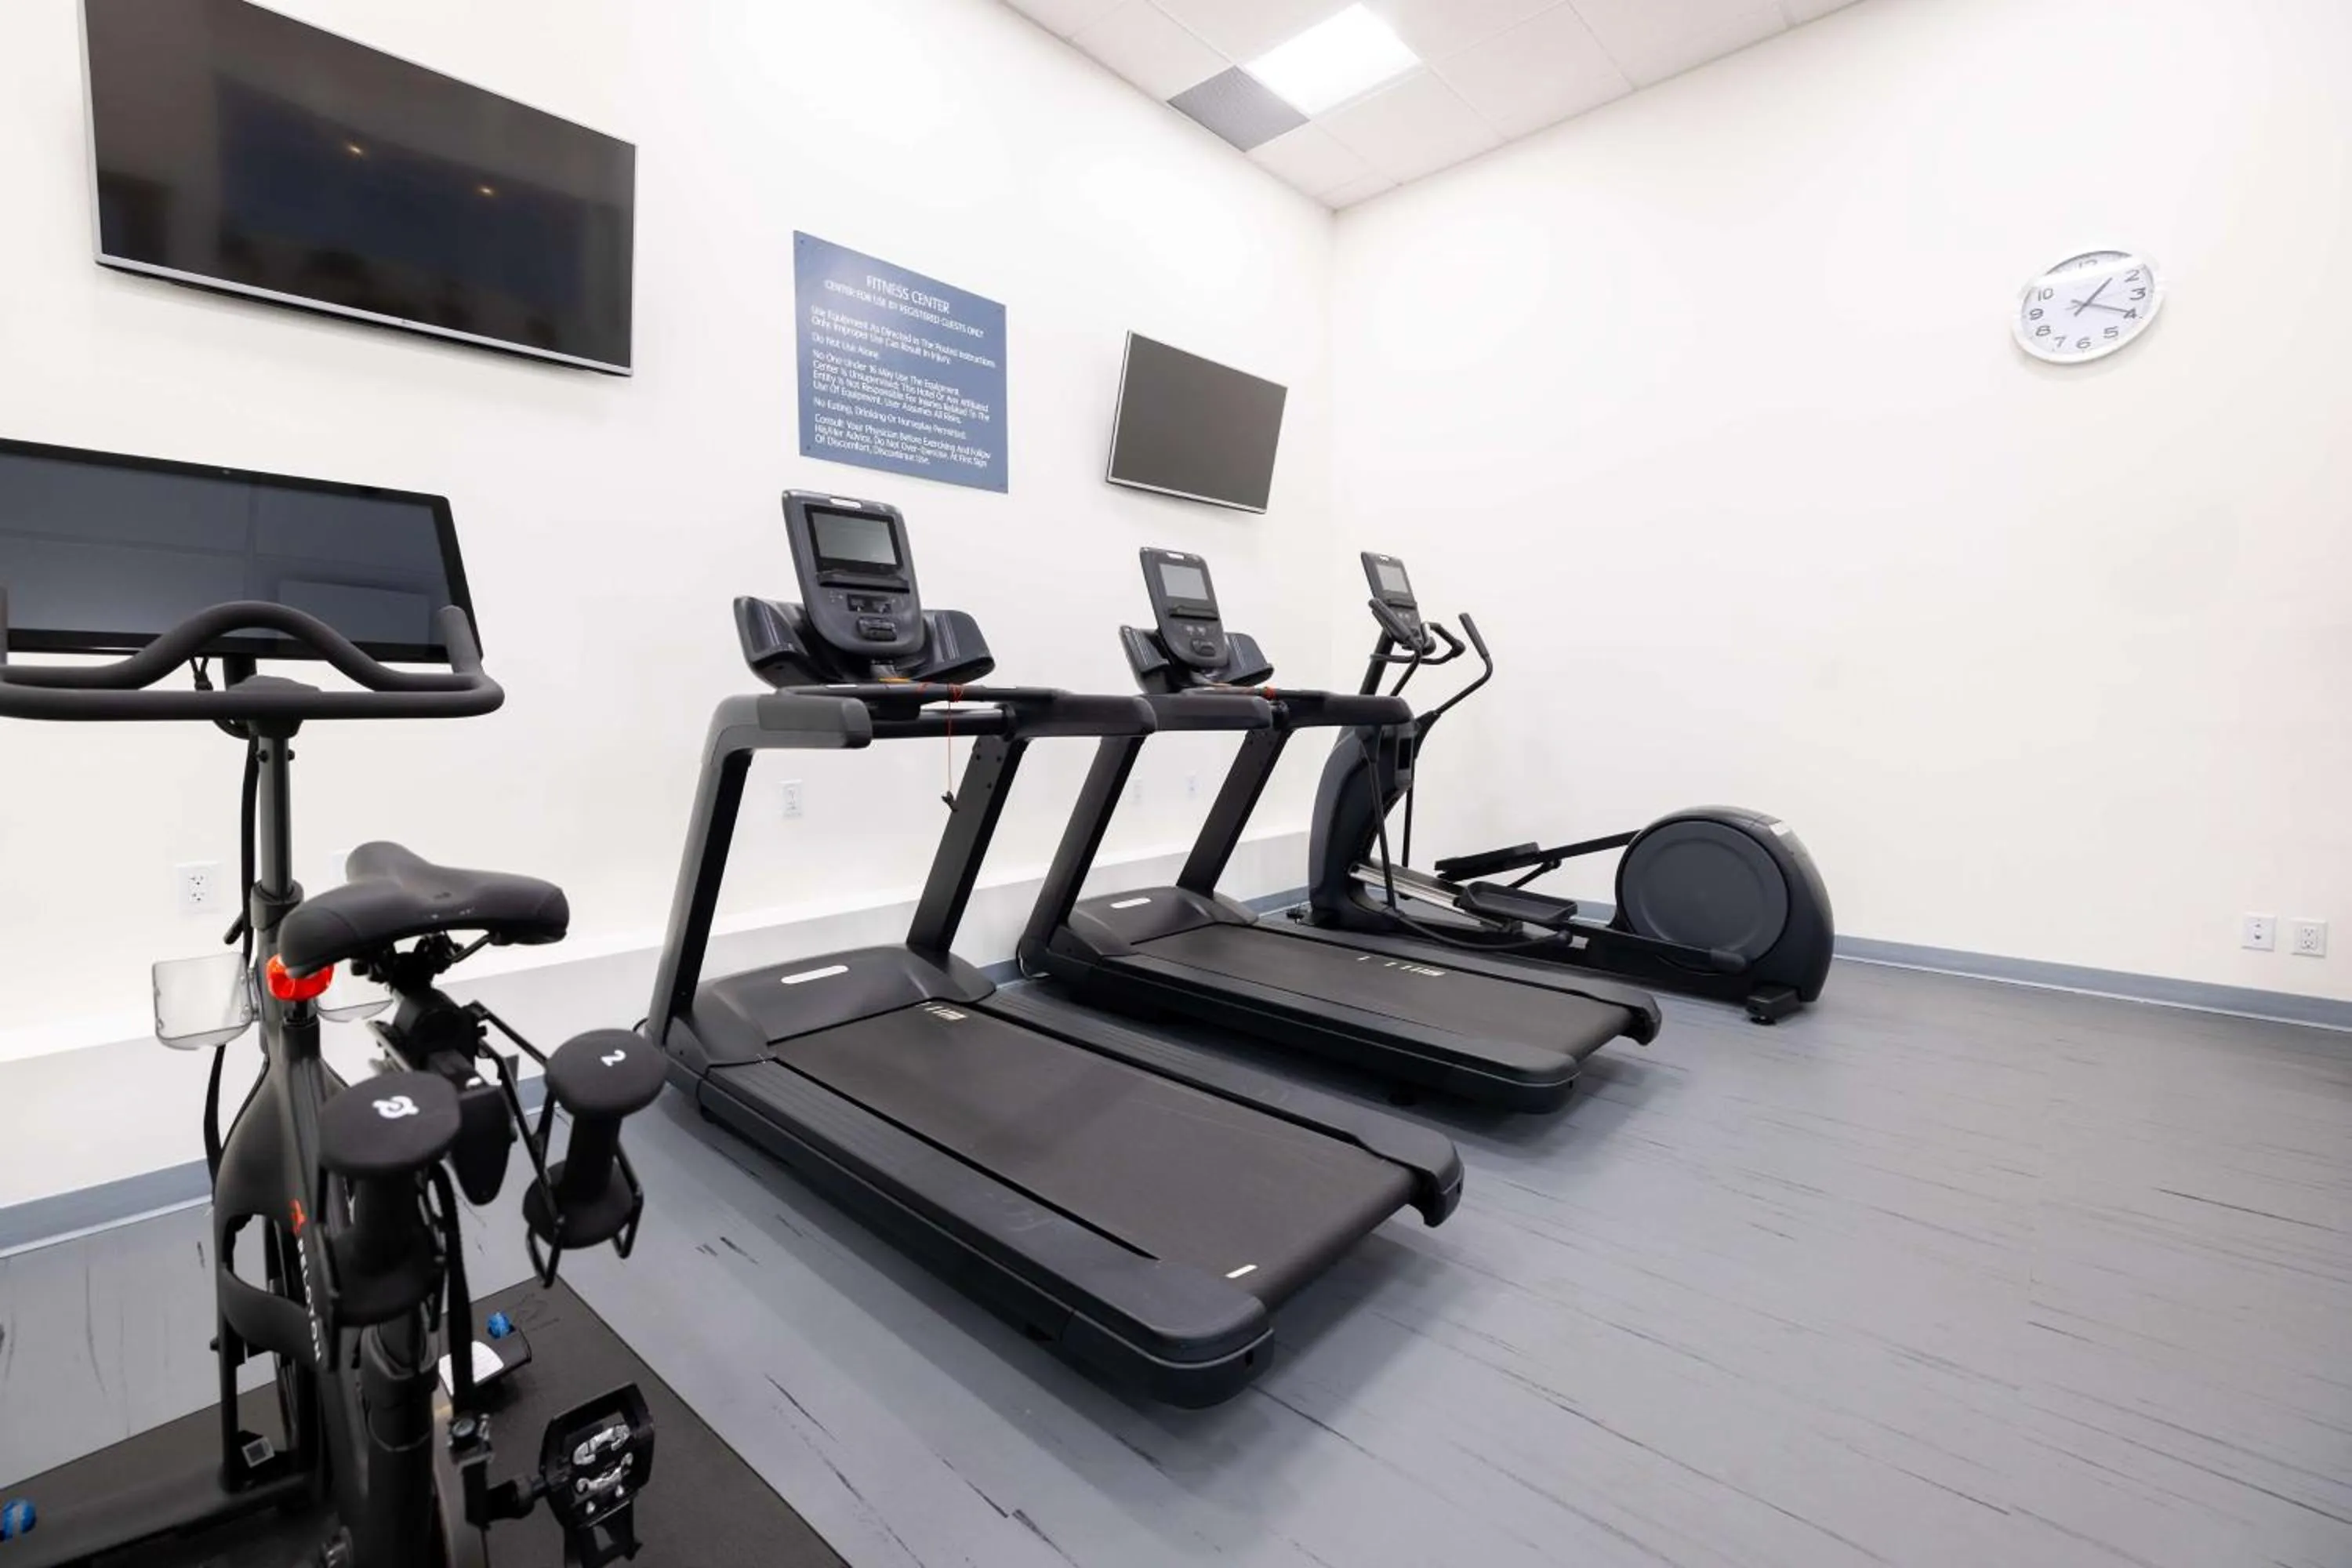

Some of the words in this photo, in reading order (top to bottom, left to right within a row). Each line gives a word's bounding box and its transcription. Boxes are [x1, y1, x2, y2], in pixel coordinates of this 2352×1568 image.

[2125, 269, 2140, 282] 2
[866, 274, 909, 300] FITNESS
[911, 290, 949, 313] CENTER
[2037, 287, 2054, 301] 10
[2129, 287, 2147, 300] 3
[2029, 308, 2045, 321] 9
[2123, 307, 2138, 319] 4
[2035, 325, 2052, 336] 8
[2103, 326, 2119, 339] 5
[826, 337, 840, 348] Not
[2054, 336, 2067, 348] 7
[2076, 336, 2092, 349] 6
[826, 354, 843, 365] One
[844, 358, 866, 371] Under
[813, 360, 838, 374] Center
[916, 387, 935, 398] Hotel
[813, 371, 836, 385] Entity
[862, 383, 903, 400] Responsible
[813, 380, 828, 391] Use
[855, 407, 886, 422] Drinking
[815, 414, 844, 428] Consult
[846, 421, 863, 432] Your
[865, 425, 898, 439] Physician
[900, 433, 922, 445] Before
[956, 445, 969, 454] And
[886, 439, 899, 448] Not
[601, 1049, 626, 1067] 2
